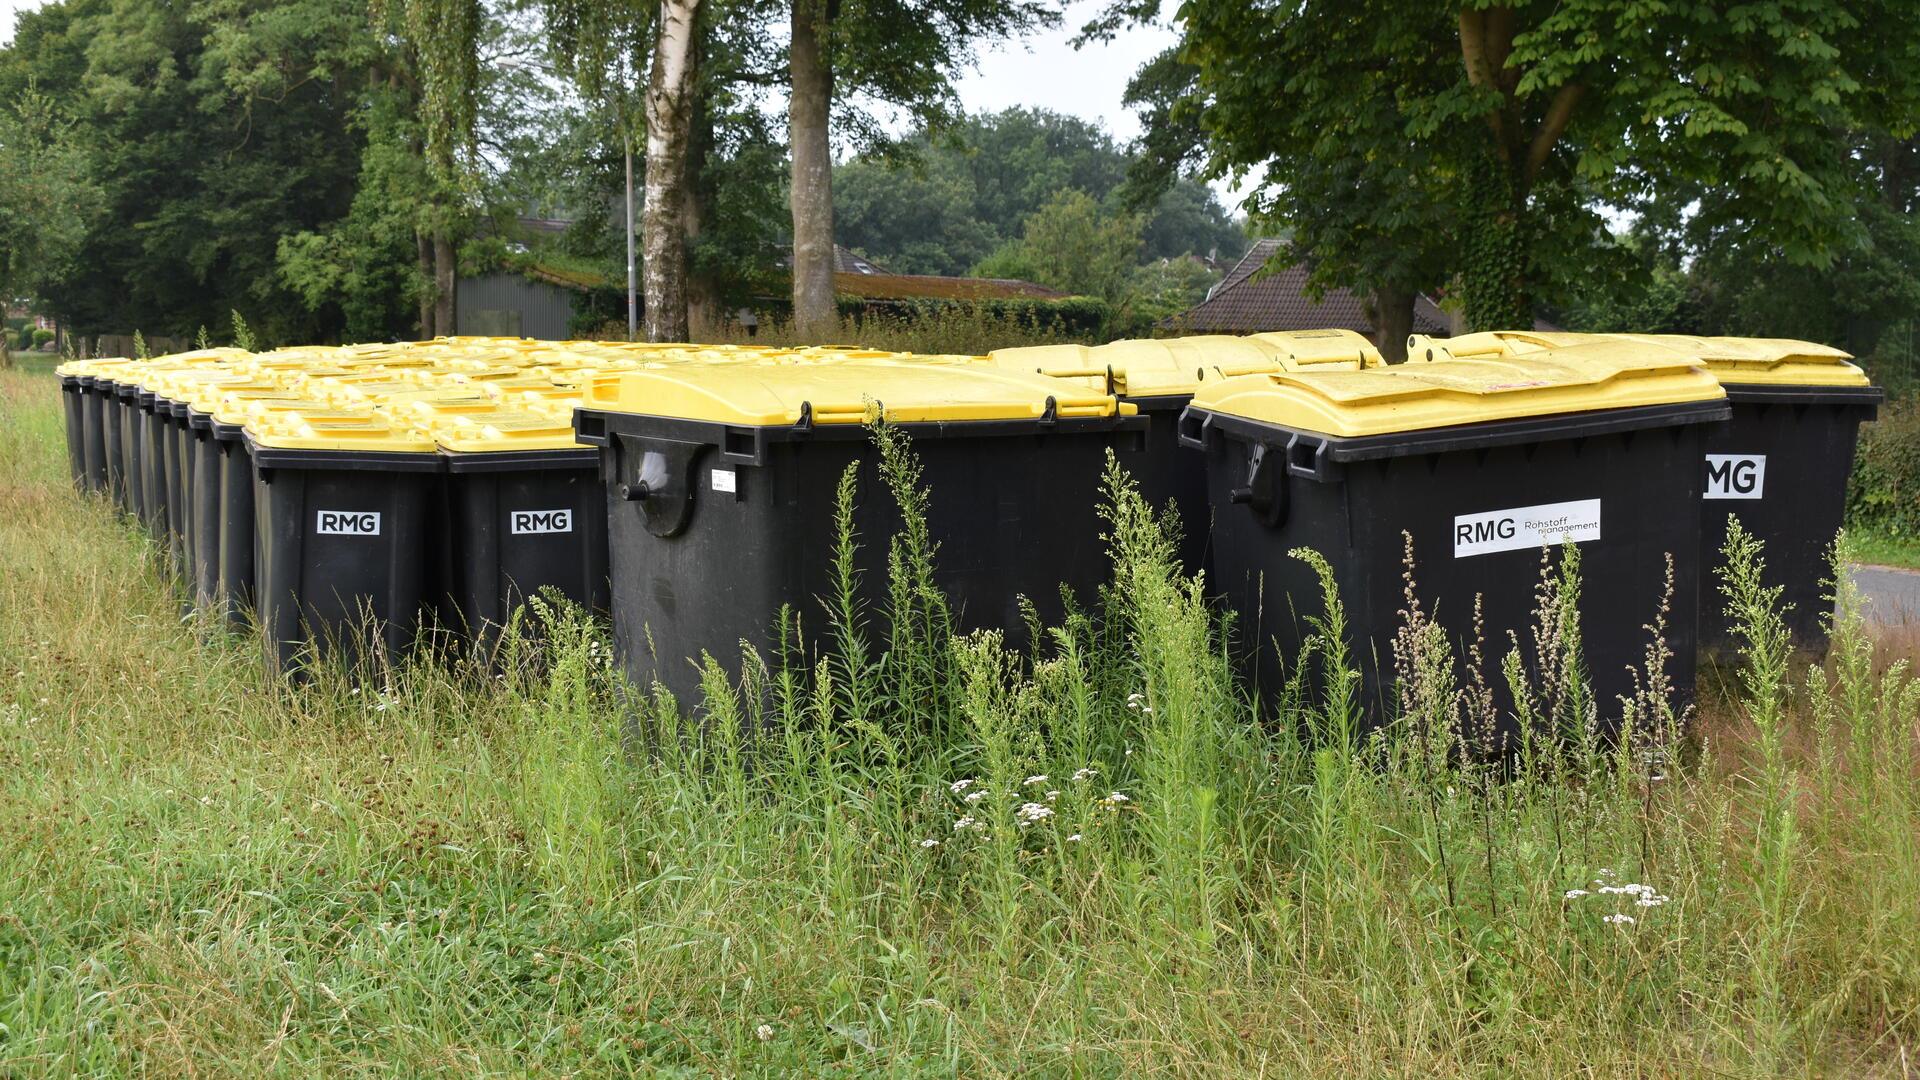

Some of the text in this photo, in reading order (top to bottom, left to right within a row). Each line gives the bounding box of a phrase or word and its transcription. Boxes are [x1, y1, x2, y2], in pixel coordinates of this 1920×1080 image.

[322, 513, 375, 532] RMG
[516, 512, 567, 531] RMG
[1456, 516, 1568, 546] RMG Rohstoff
